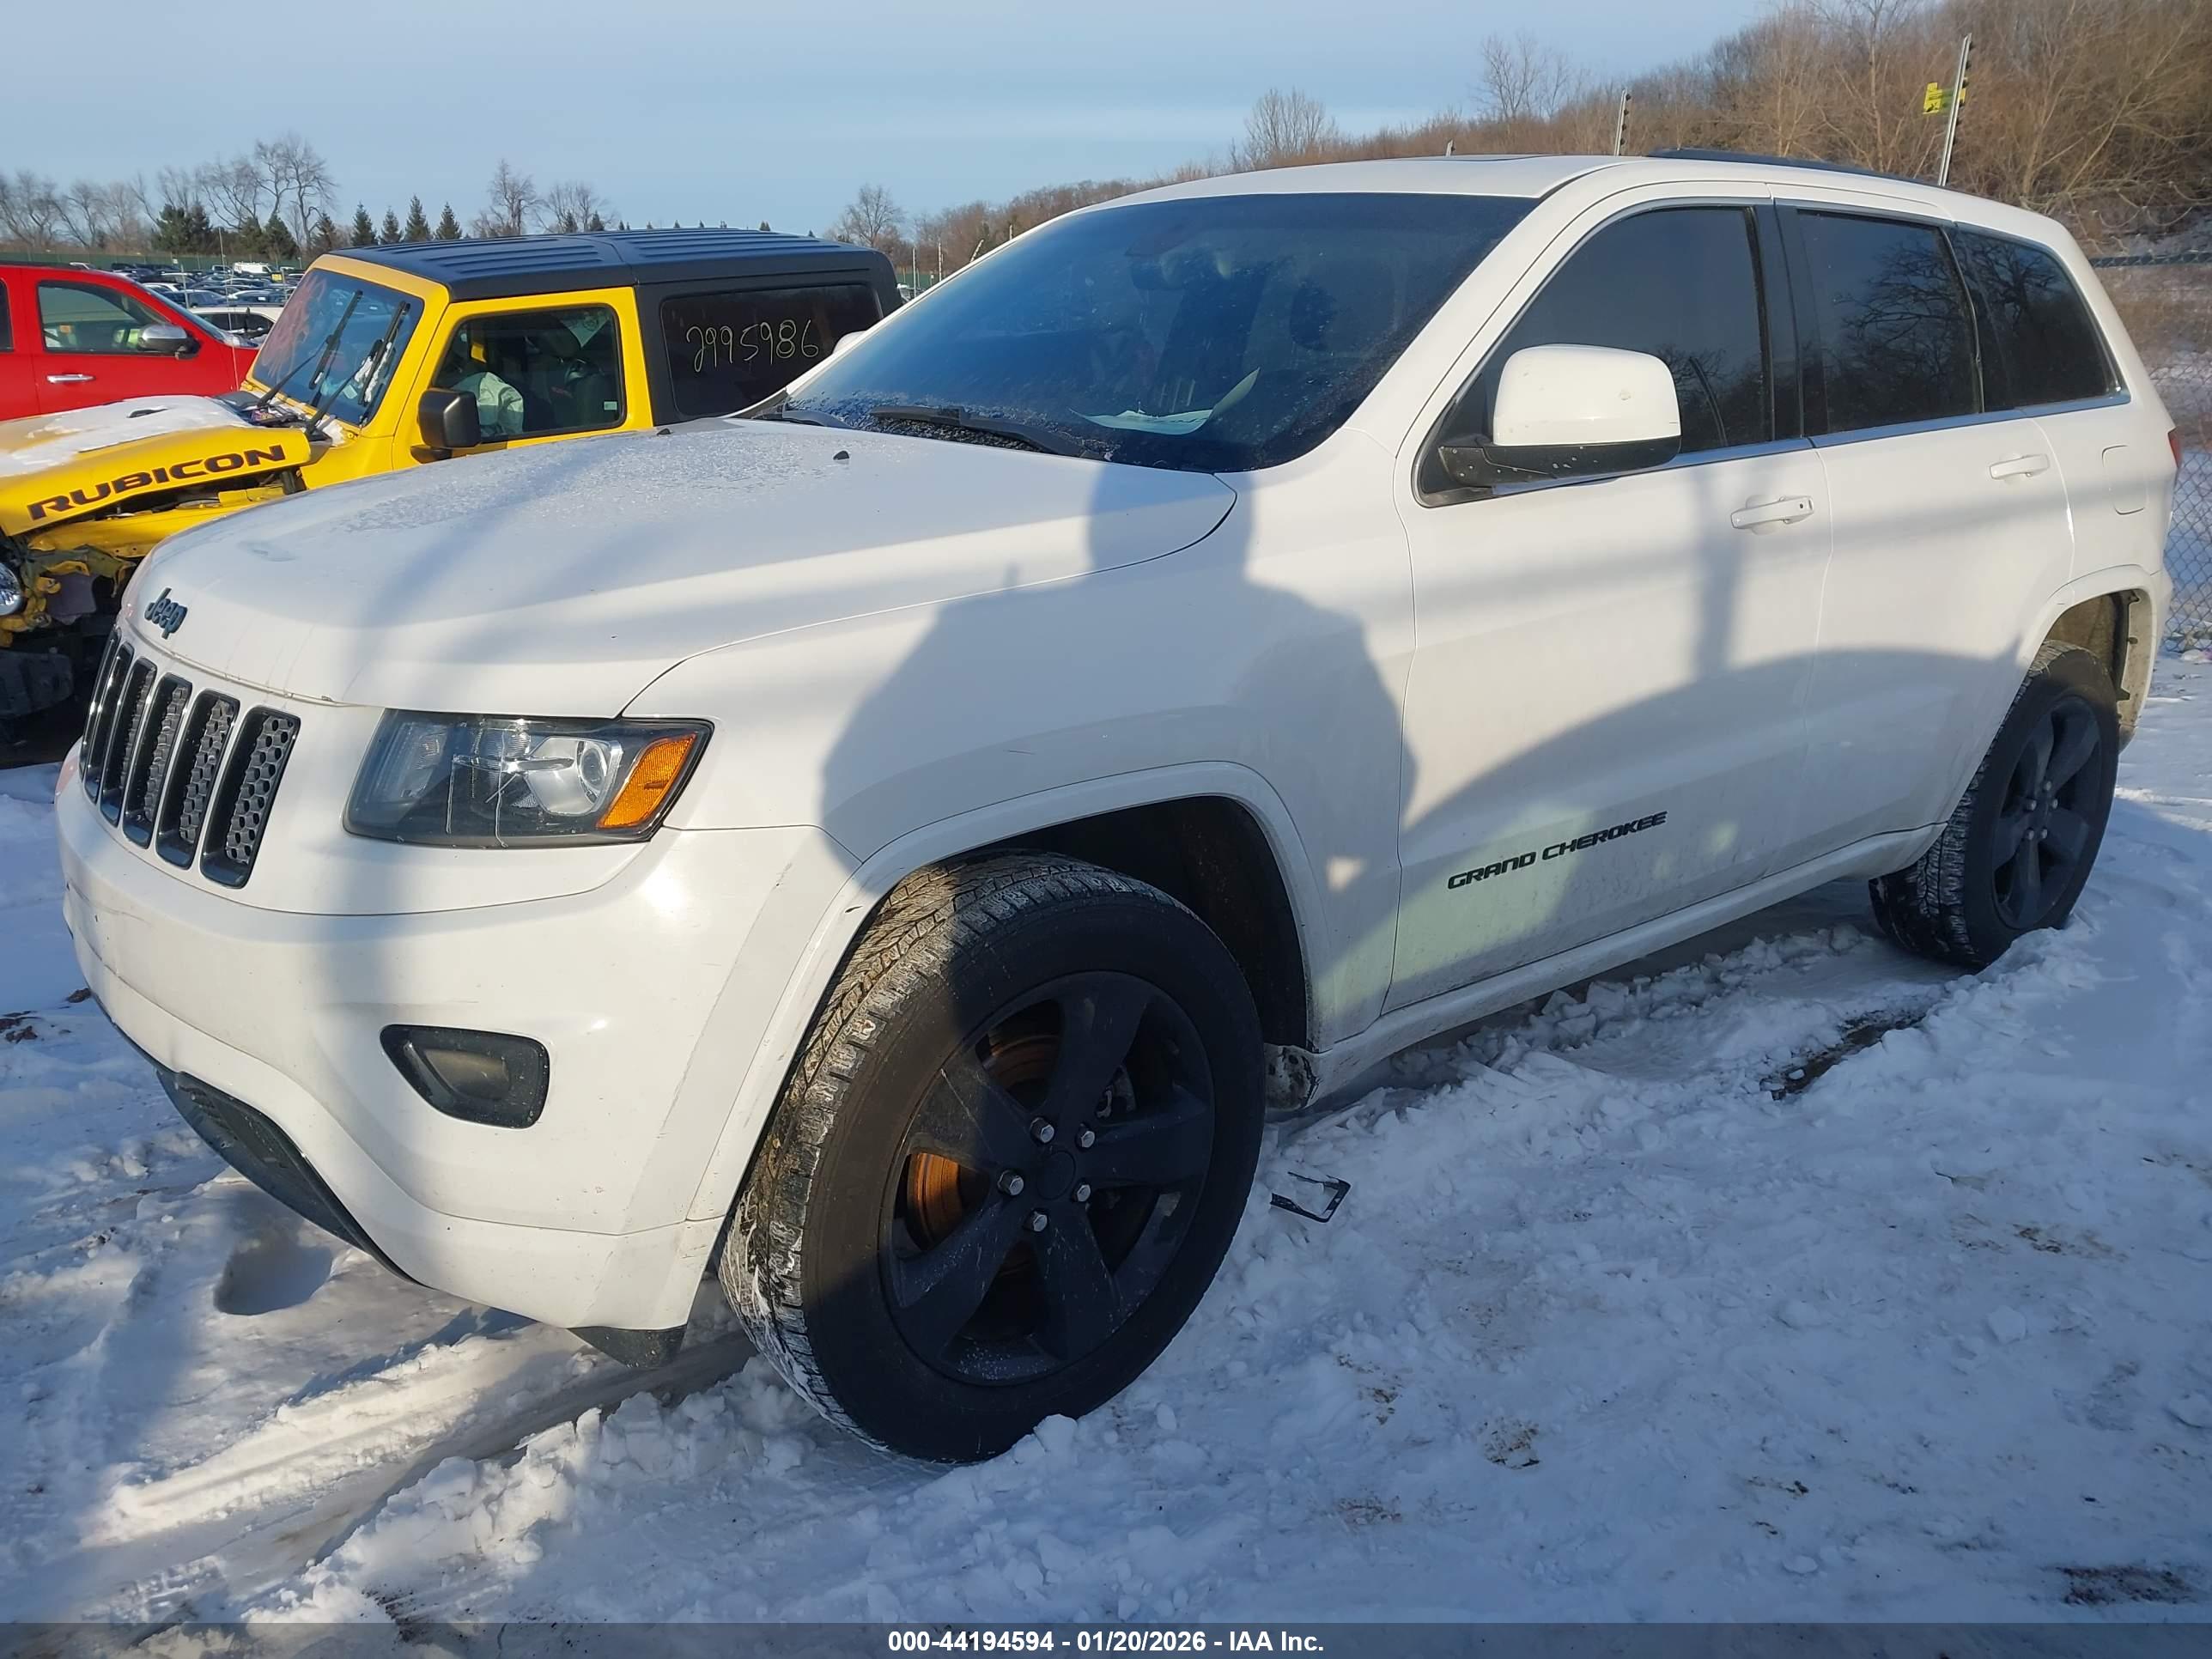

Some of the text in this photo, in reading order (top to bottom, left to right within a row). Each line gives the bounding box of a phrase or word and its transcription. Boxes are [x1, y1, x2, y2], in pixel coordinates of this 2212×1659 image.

[686, 319, 819, 373] 2995986
[27, 444, 286, 521] RUBICON
[143, 586, 188, 641] Jeep
[1447, 810, 1668, 890] GRAND CHEROKEE
